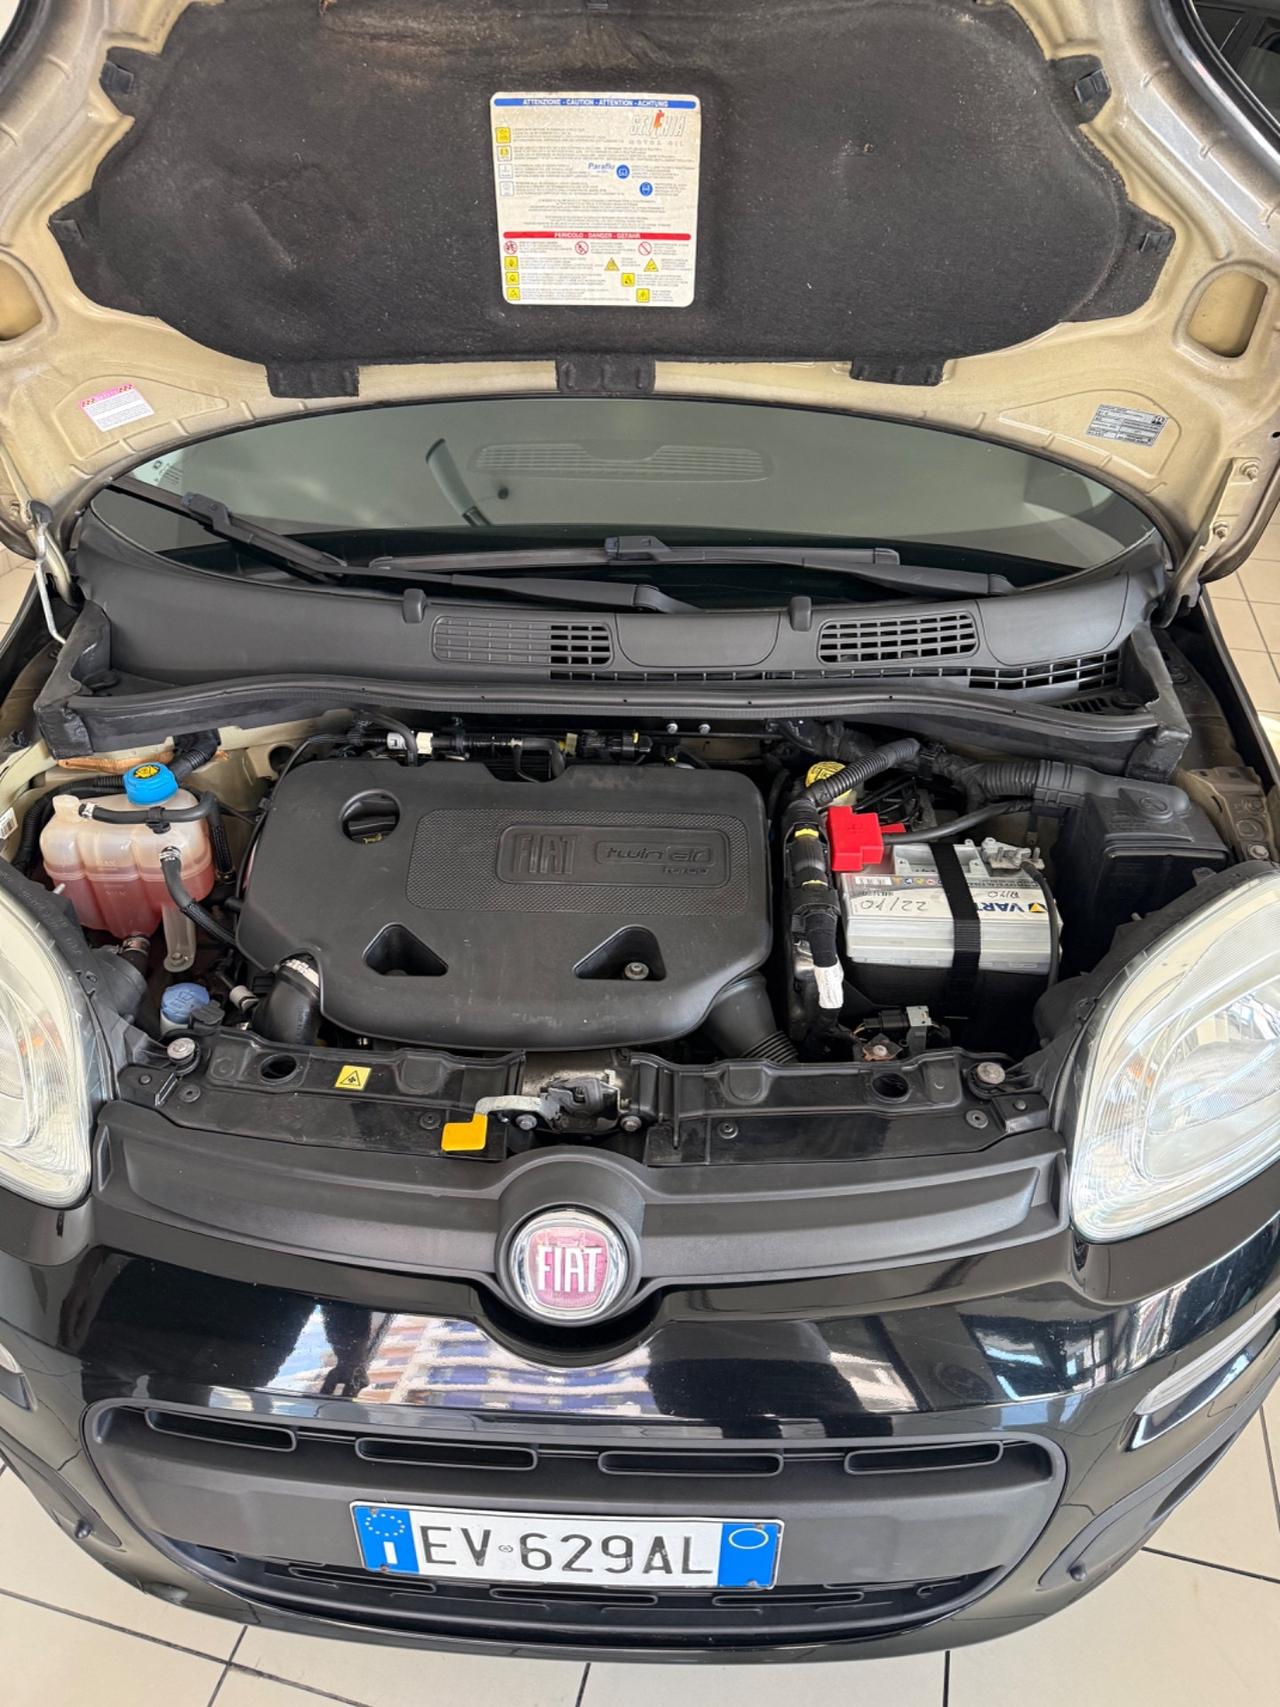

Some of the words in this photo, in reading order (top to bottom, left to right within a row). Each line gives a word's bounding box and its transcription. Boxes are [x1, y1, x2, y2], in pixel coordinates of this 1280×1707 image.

[522, 98, 561, 106] ATTENZIONE
[566, 98, 594, 106] CAUTION
[599, 99, 633, 107] ATTENTION
[636, 100, 668, 108] ACHTUNG
[588, 232, 612, 240] DANGER
[513, 834, 577, 875] FIAT
[976, 902, 1025, 913] VAR
[535, 1245, 602, 1293] FIAT
[419, 1525, 492, 1567] EV
[519, 1531, 713, 1576] 629AL
